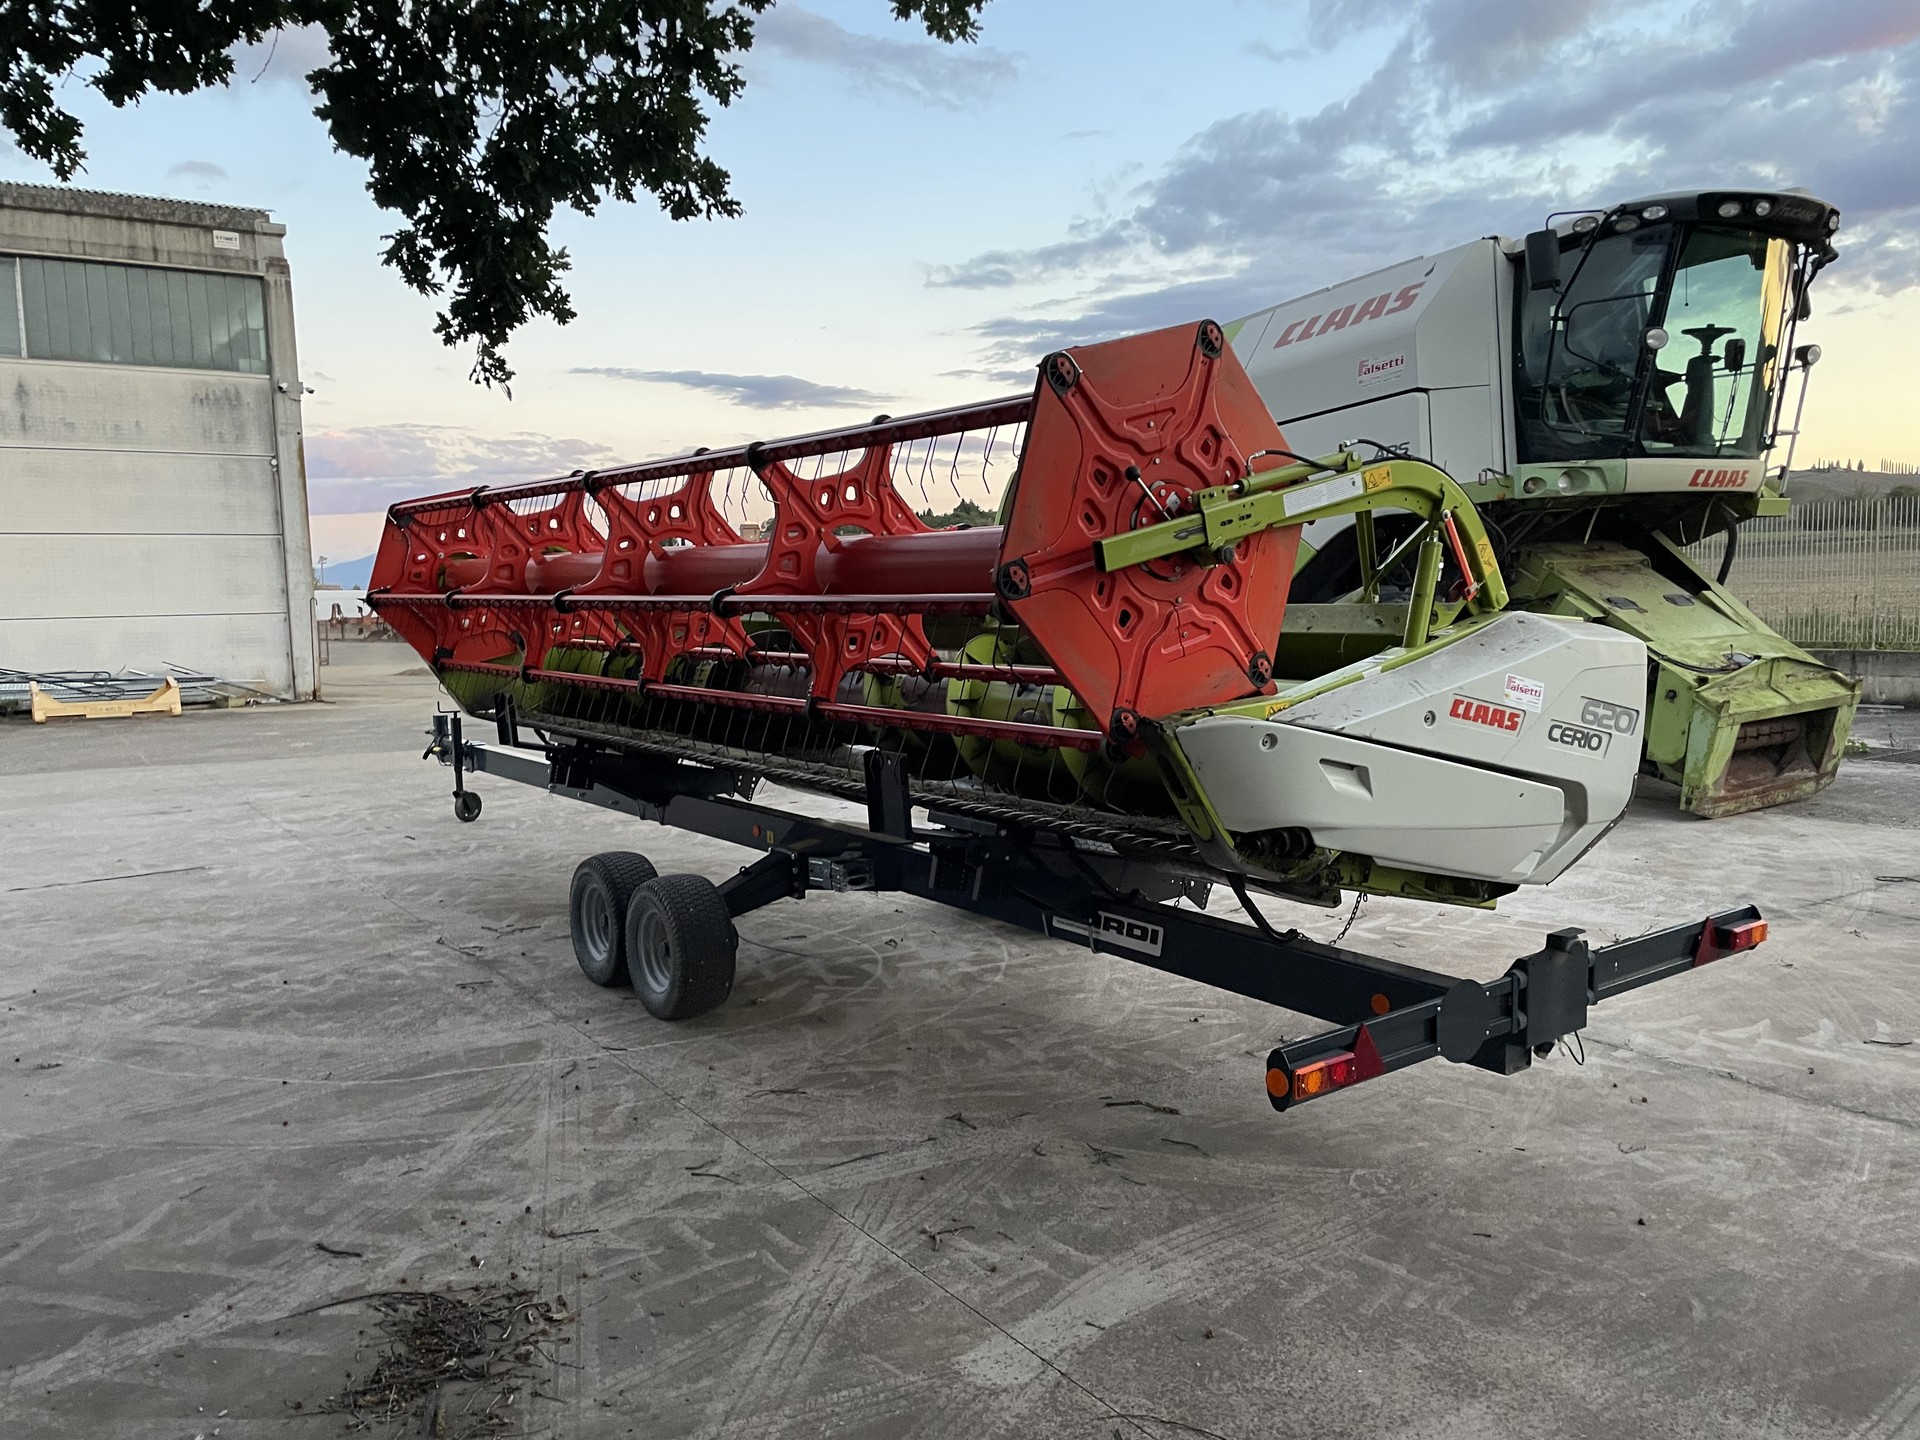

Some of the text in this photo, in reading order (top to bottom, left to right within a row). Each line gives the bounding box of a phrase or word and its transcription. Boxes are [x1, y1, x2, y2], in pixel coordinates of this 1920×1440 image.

[1273, 281, 1427, 349] CLAAS
[1358, 355, 1404, 377] Falsetti
[1688, 469, 1750, 488] CLAAS
[1506, 674, 1542, 698] Falsetti
[1449, 698, 1521, 732] CLAAS
[1581, 700, 1634, 734] 620
[1548, 723, 1603, 752] CERIO
